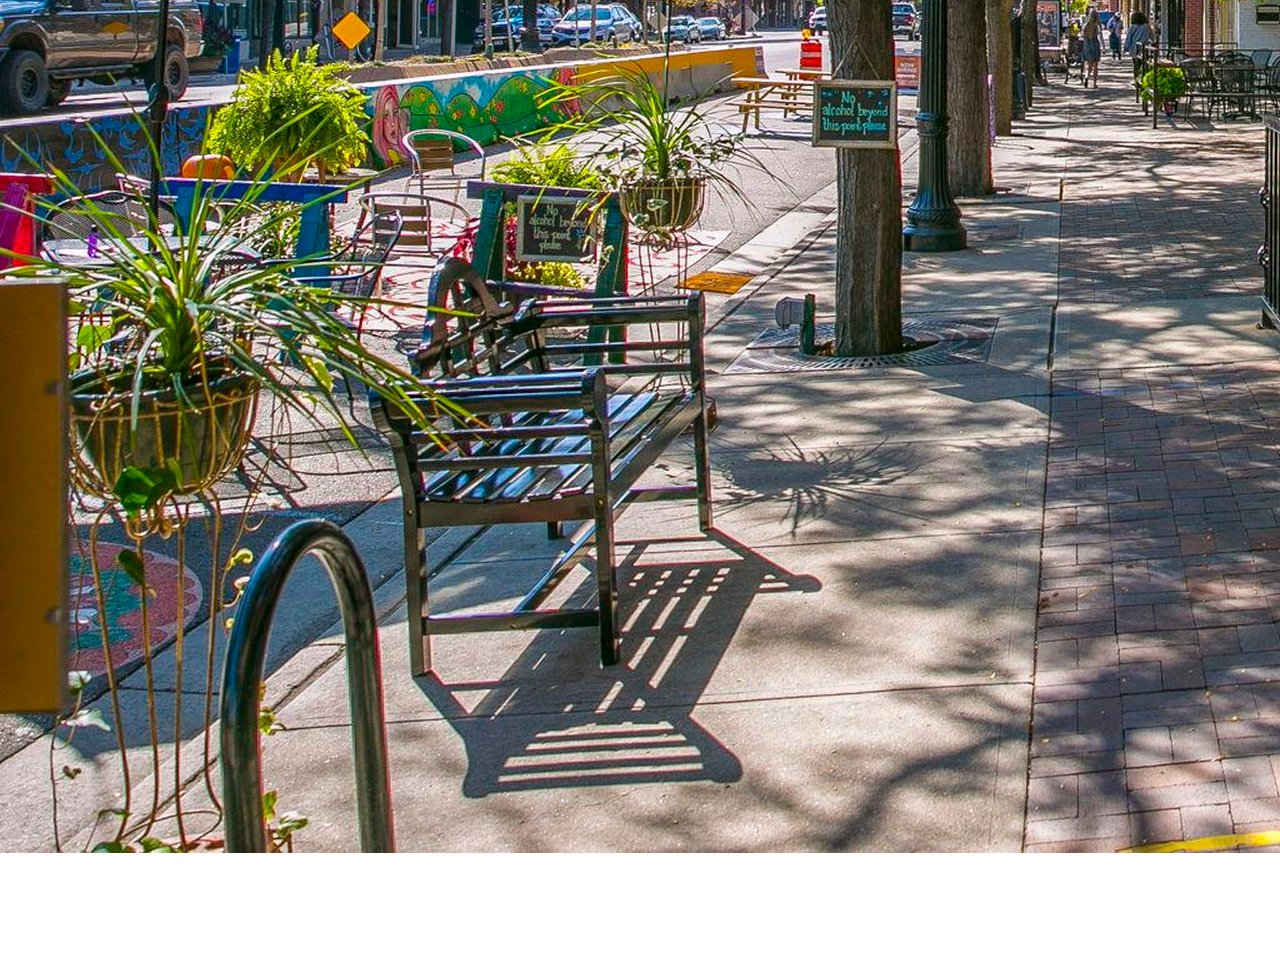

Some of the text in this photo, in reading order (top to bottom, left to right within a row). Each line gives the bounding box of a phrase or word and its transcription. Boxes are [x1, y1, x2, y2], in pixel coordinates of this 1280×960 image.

[842, 91, 856, 103] No
[822, 103, 889, 123] alcohol beyond
[823, 118, 839, 131] this
[841, 118, 860, 135] point
[546, 204, 559, 216] No
[529, 213, 556, 227] alcohol
[539, 240, 562, 253] please
